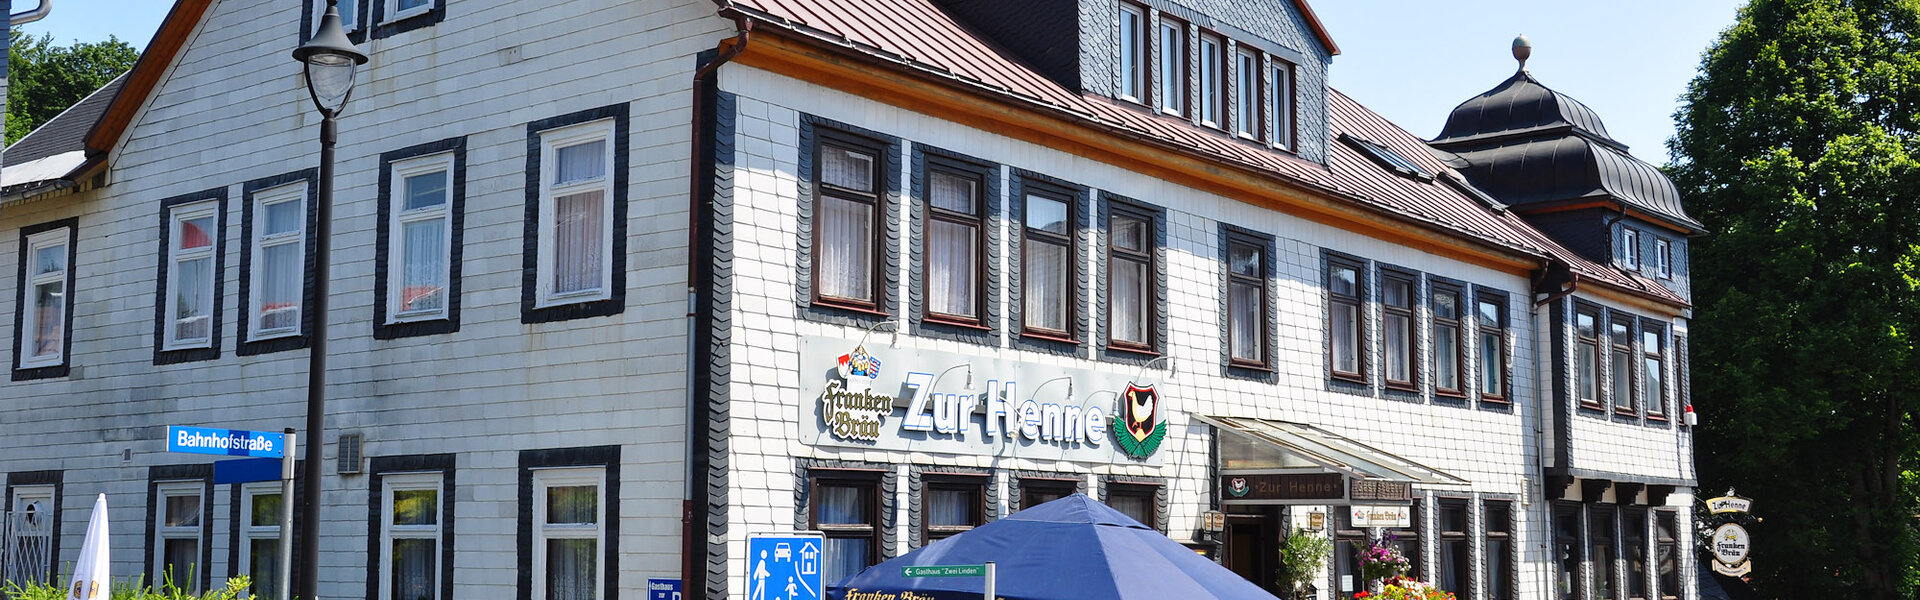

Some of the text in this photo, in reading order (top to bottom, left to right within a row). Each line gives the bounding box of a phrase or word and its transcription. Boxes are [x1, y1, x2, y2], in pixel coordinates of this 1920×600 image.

[824, 382, 891, 423] Franken
[903, 372, 1107, 445] Zur Henne
[835, 411, 880, 438] Bräu
[178, 430, 273, 451] Bahnhofstraße
[1259, 480, 1331, 494] Zur Henne
[1716, 541, 1745, 552] Franken
[915, 568, 941, 576] Gasthaus
